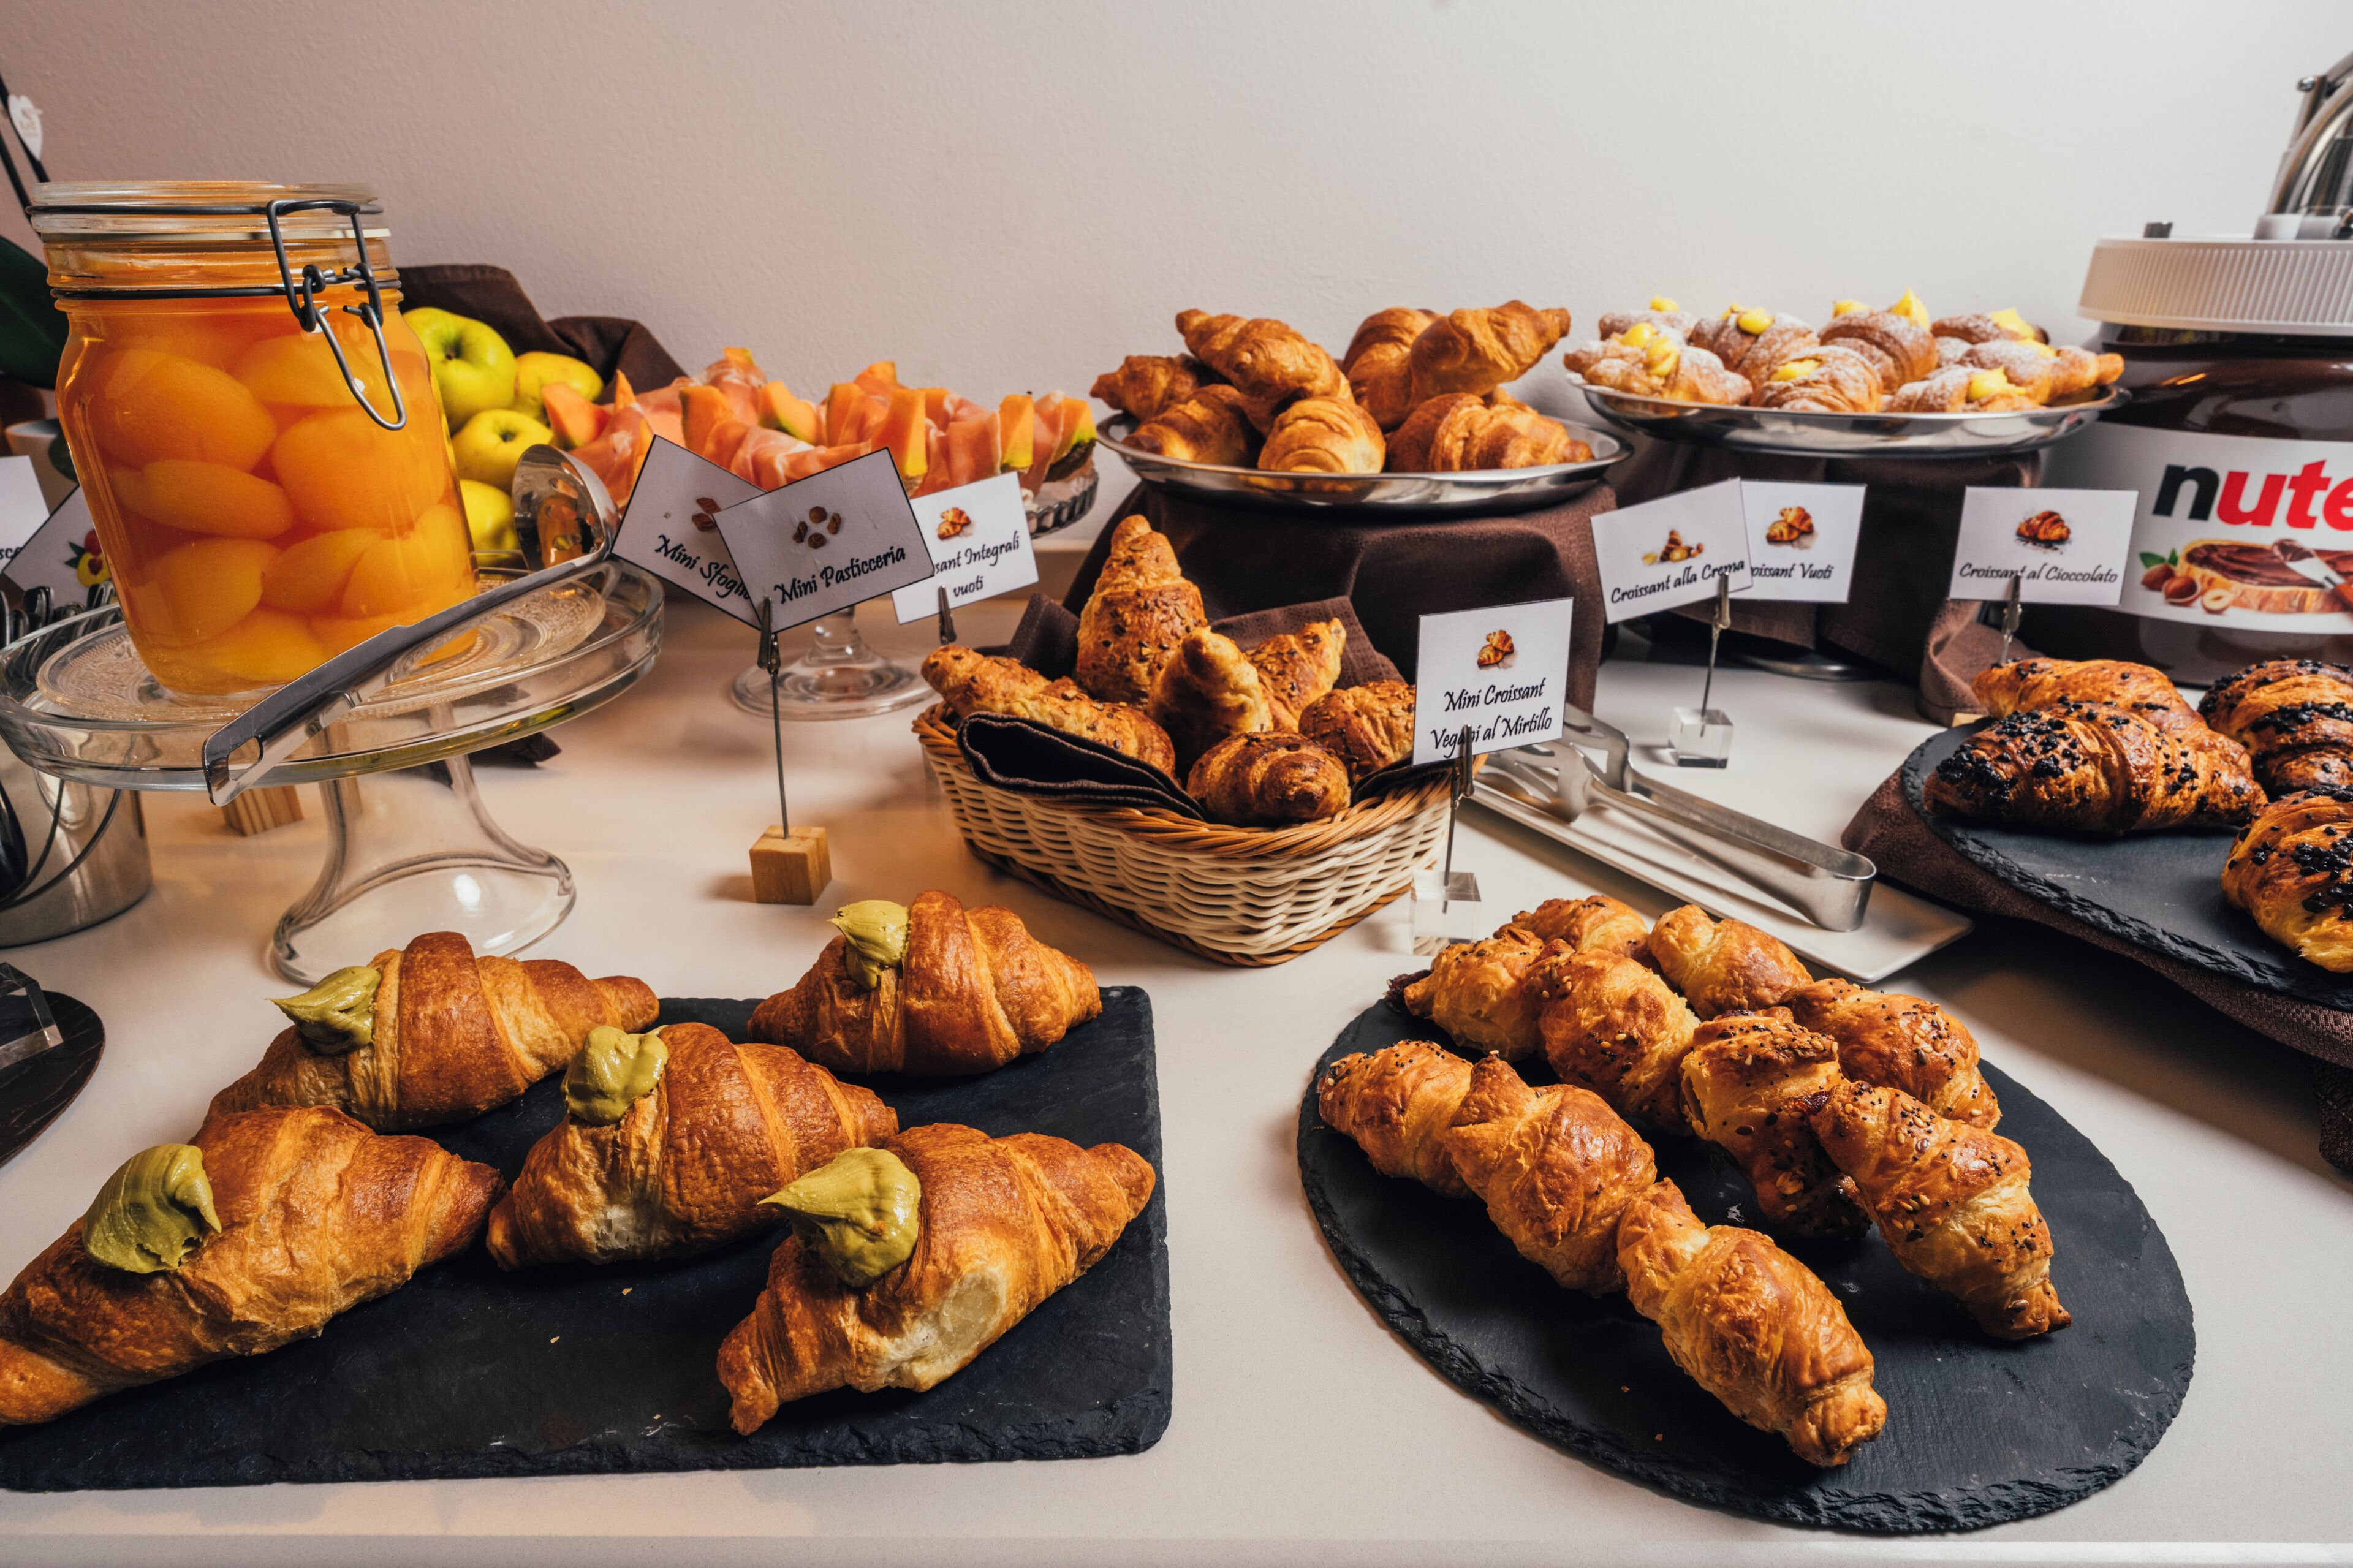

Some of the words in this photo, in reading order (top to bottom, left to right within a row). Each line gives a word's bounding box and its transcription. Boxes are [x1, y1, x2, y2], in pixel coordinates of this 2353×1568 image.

[654, 534, 700, 570] Mini
[964, 530, 1020, 566] Integrali
[773, 574, 818, 604] Mini
[819, 545, 906, 588] Pasticceria
[953, 575, 983, 597] vuoti
[1610, 574, 1671, 604] Croissant
[1673, 566, 1697, 588] alla
[1702, 560, 1745, 580] Crema
[1751, 562, 1796, 578] oissant
[1799, 563, 1835, 580] Vuoti
[2026, 562, 2048, 580] al
[2045, 564, 2118, 583] Cioccolato
[1444, 689, 1482, 712] Mini
[1483, 677, 1547, 705] Croissant
[1482, 714, 1501, 741] al
[1501, 706, 1552, 738] Mirtillo
